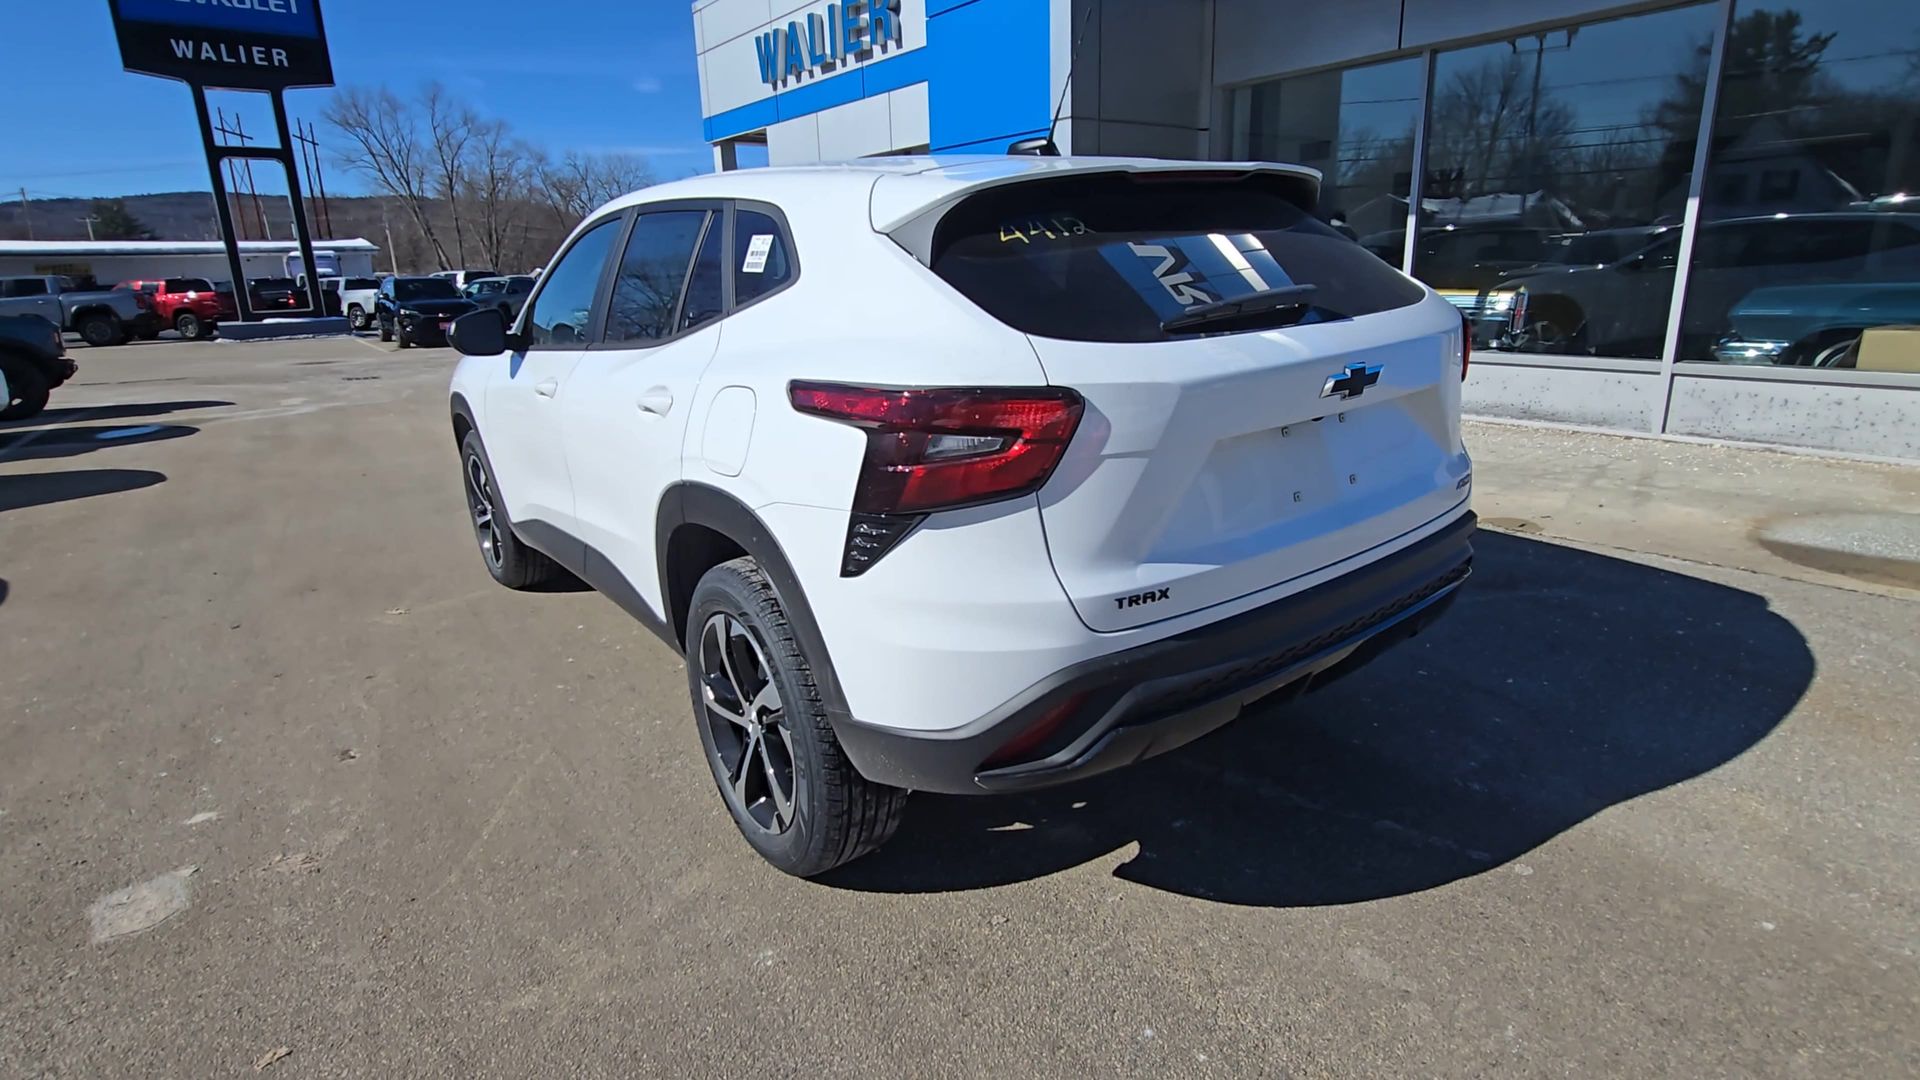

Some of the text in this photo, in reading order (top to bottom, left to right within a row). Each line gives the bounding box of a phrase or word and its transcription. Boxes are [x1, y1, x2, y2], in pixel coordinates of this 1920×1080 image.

[170, 38, 289, 68] WALIER
[755, 0, 902, 84] WALIER
[1114, 587, 1170, 609] TRAX
